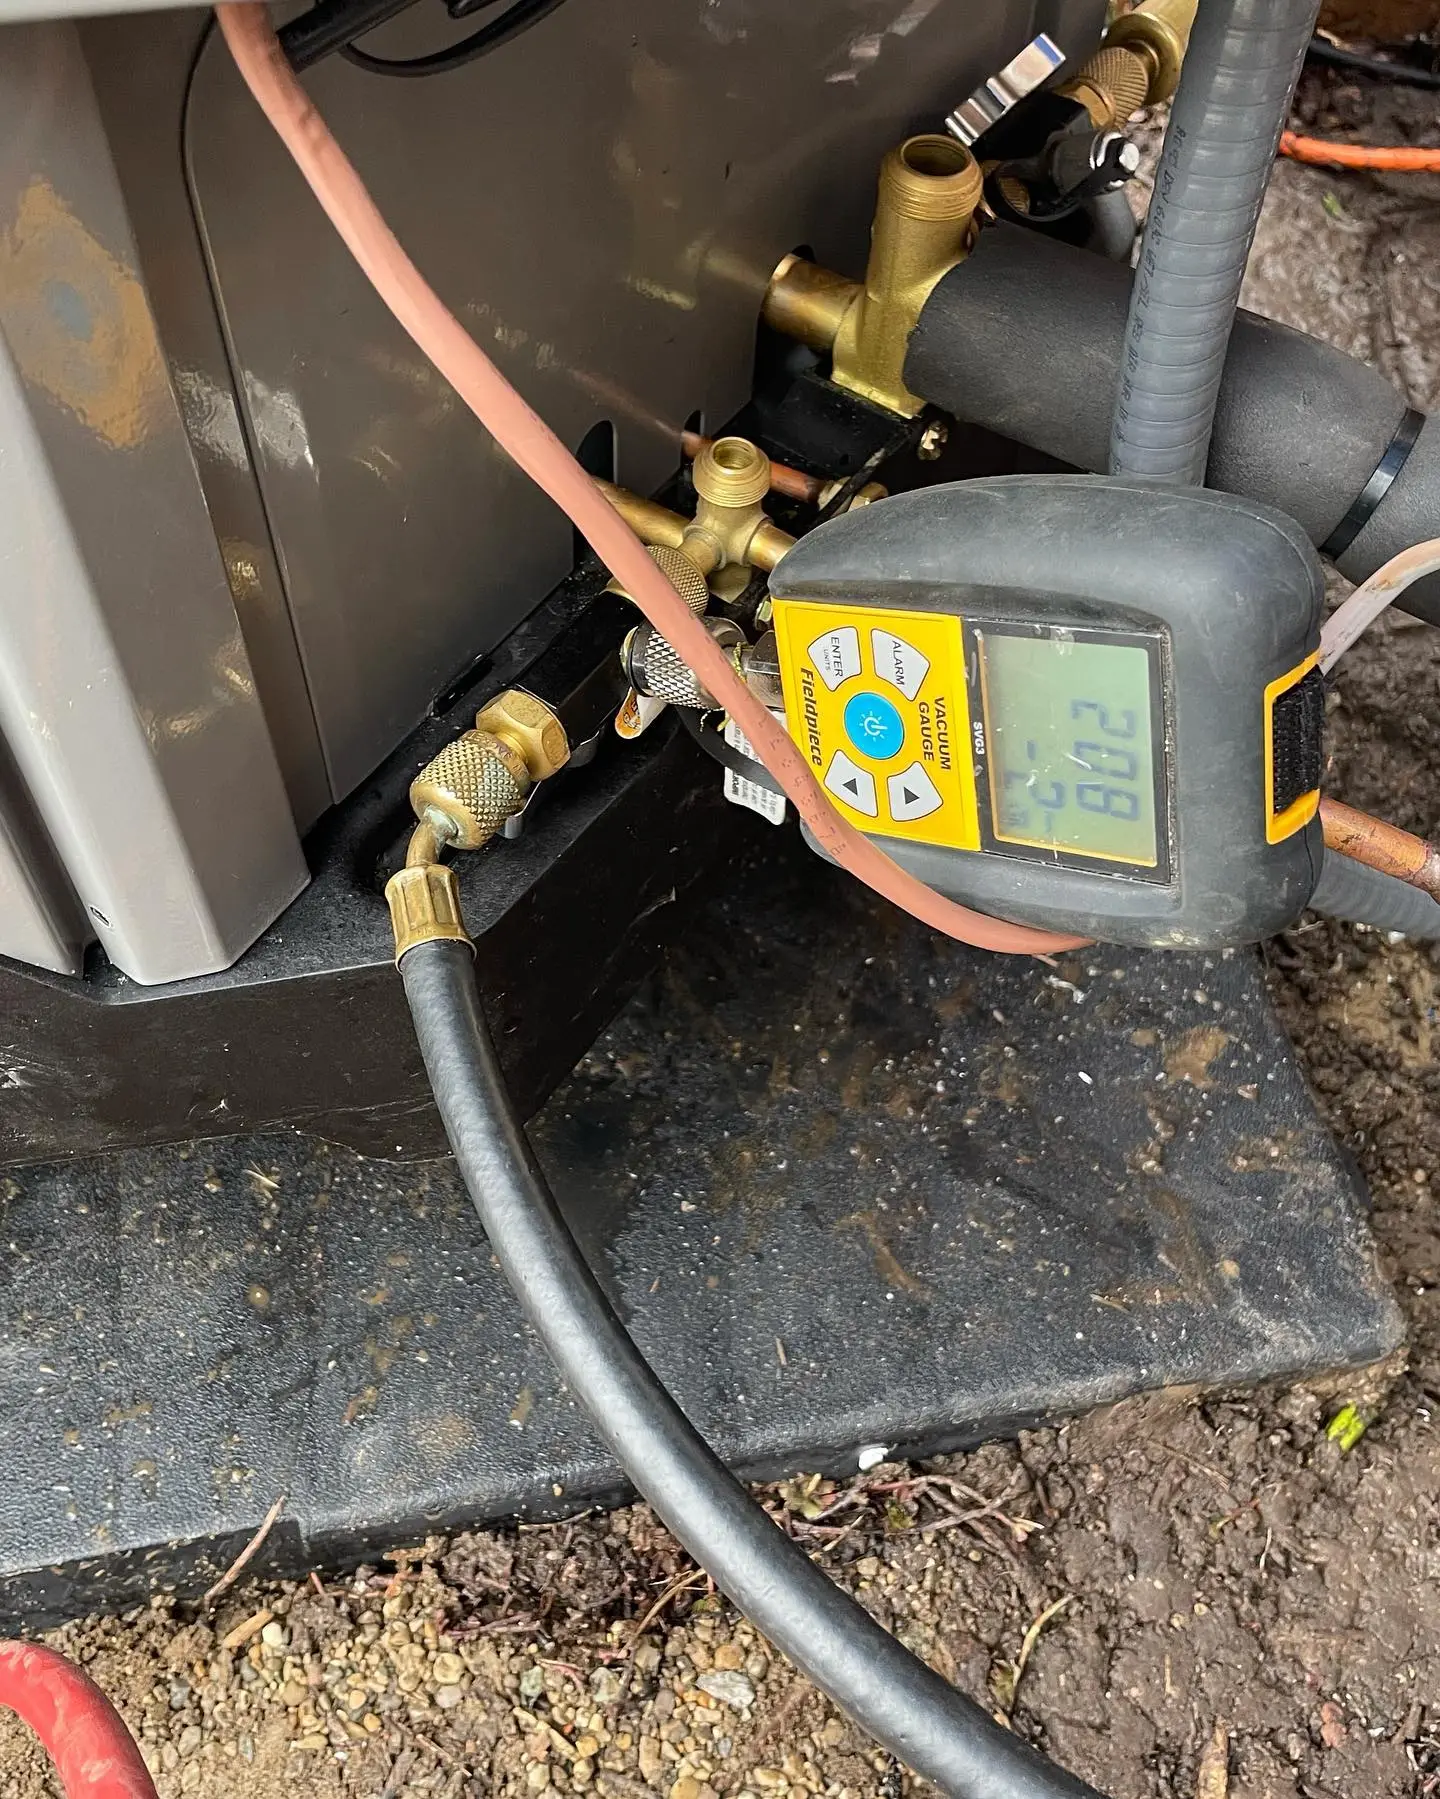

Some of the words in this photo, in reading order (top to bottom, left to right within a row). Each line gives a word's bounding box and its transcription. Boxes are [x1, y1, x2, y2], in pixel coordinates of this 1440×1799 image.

[823, 648, 832, 672] UNITS
[831, 636, 844, 677] ENTER
[892, 640, 905, 686] ALARM
[800, 667, 823, 767] Fieldpiece
[918, 701, 935, 762] GAUGE
[934, 696, 952, 770] VACUUM
[973, 721, 986, 756] SVG3
[1070, 698, 1140, 822] 208
